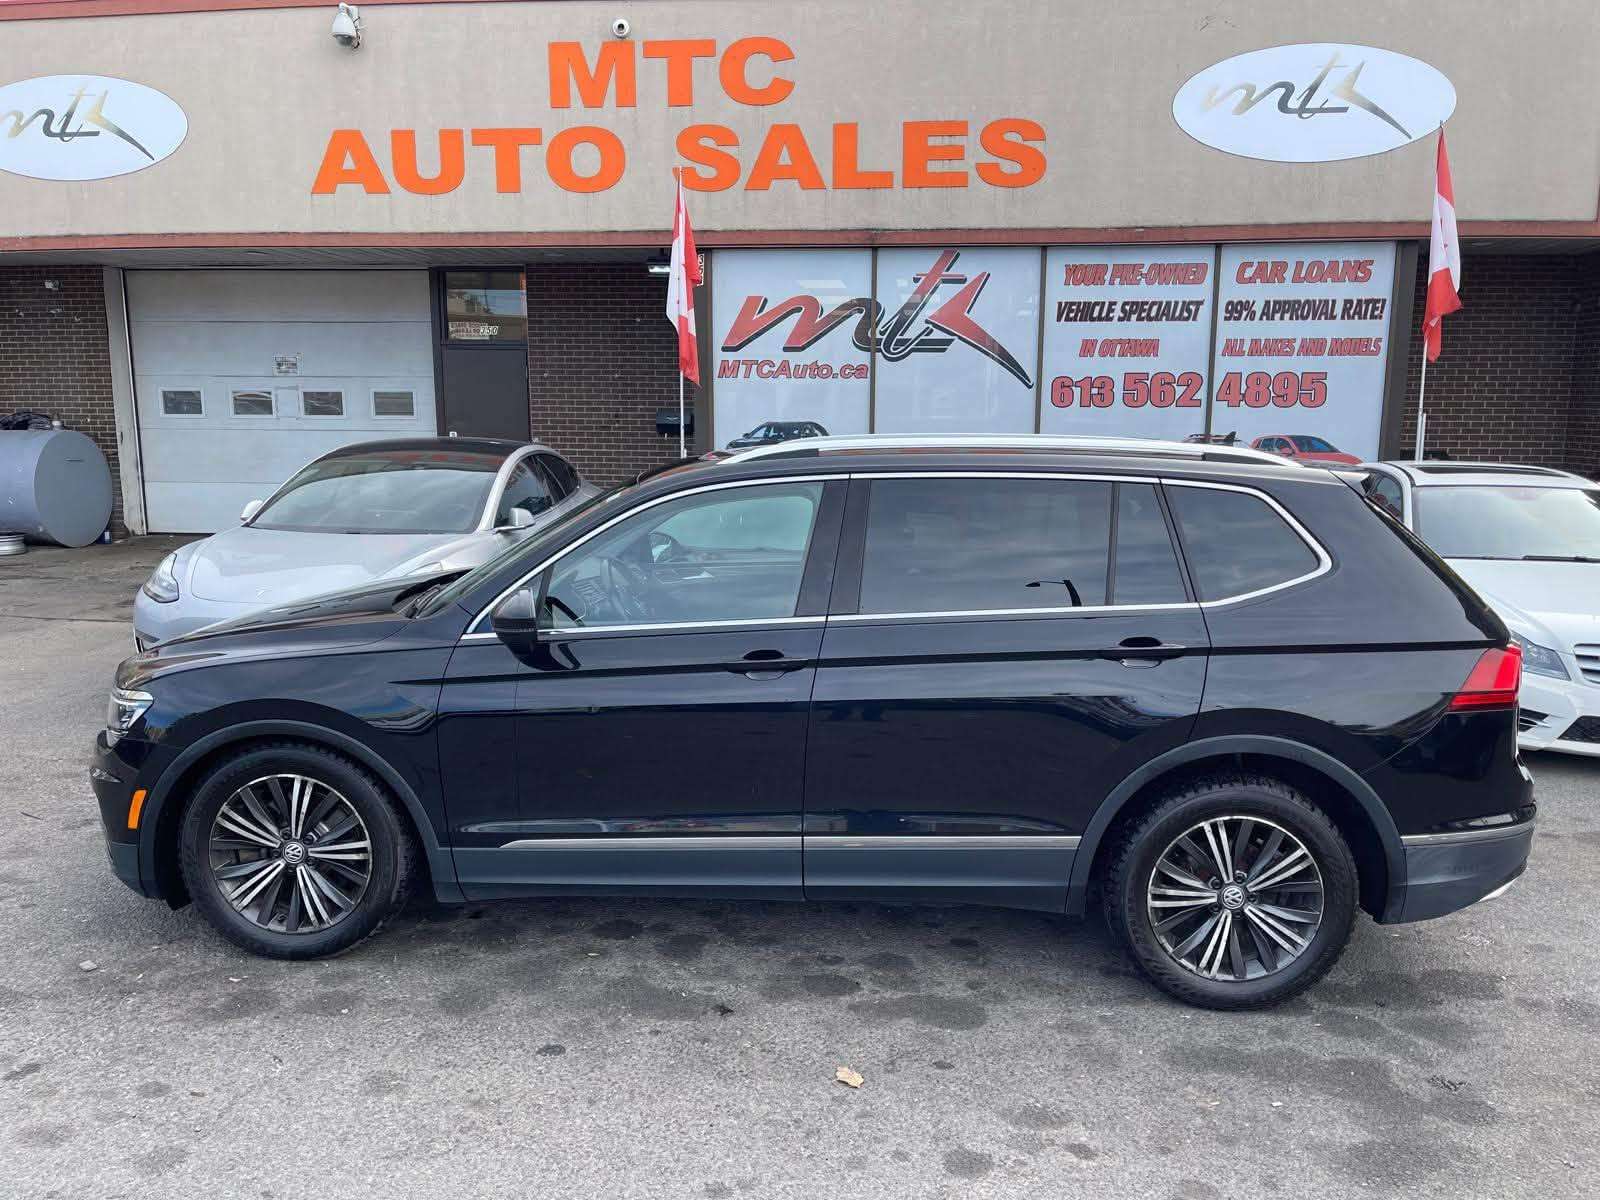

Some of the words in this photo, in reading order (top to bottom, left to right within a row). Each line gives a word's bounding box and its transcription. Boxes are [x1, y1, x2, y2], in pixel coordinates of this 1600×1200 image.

[548, 36, 795, 109] MTC
[310, 126, 626, 195] AUTO
[672, 118, 1047, 192] SALES
[1064, 263, 1108, 286] YOUR
[1109, 263, 1208, 286] PRE-OWNED
[1235, 261, 1288, 285] CAR
[1292, 259, 1374, 284] LOANS
[1056, 301, 1117, 322] VEHICLE
[1117, 299, 1205, 322] SPECIALIST
[1224, 300, 1256, 321] 99%
[1259, 299, 1337, 321] APPROVAL
[1340, 298, 1387, 320] RATE!
[1079, 338, 1098, 357] IN
[1098, 338, 1160, 357] OTTAWA
[1222, 338, 1246, 356] ALL
[1247, 338, 1296, 356] MAKES
[1297, 338, 1328, 356] AND
[1327, 337, 1383, 356] MODELS
[717, 360, 869, 379] MTCAuto.ca
[1050, 375, 1115, 408] 613
[1122, 371, 1204, 408] 562
[1216, 371, 1328, 408] 4895
